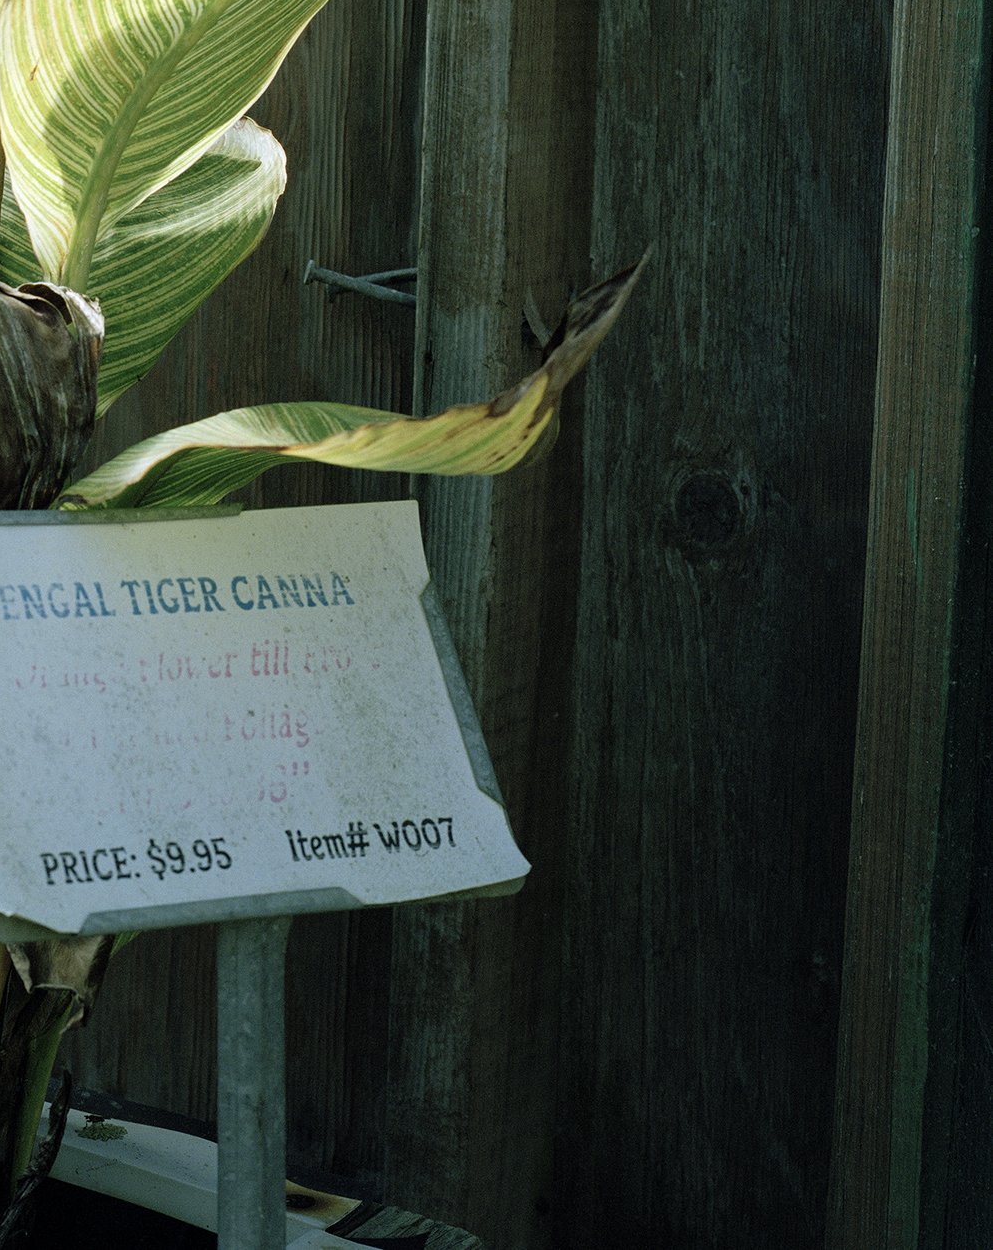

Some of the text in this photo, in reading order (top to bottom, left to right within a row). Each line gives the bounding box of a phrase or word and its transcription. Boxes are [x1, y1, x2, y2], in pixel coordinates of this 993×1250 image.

[120, 576, 225, 616] TIGER
[231, 571, 355, 611] CANNA
[251, 638, 290, 678] till
[223, 706, 324, 748] foliag
[40, 816, 458, 885] PRICE: $9.95 Item# W007
